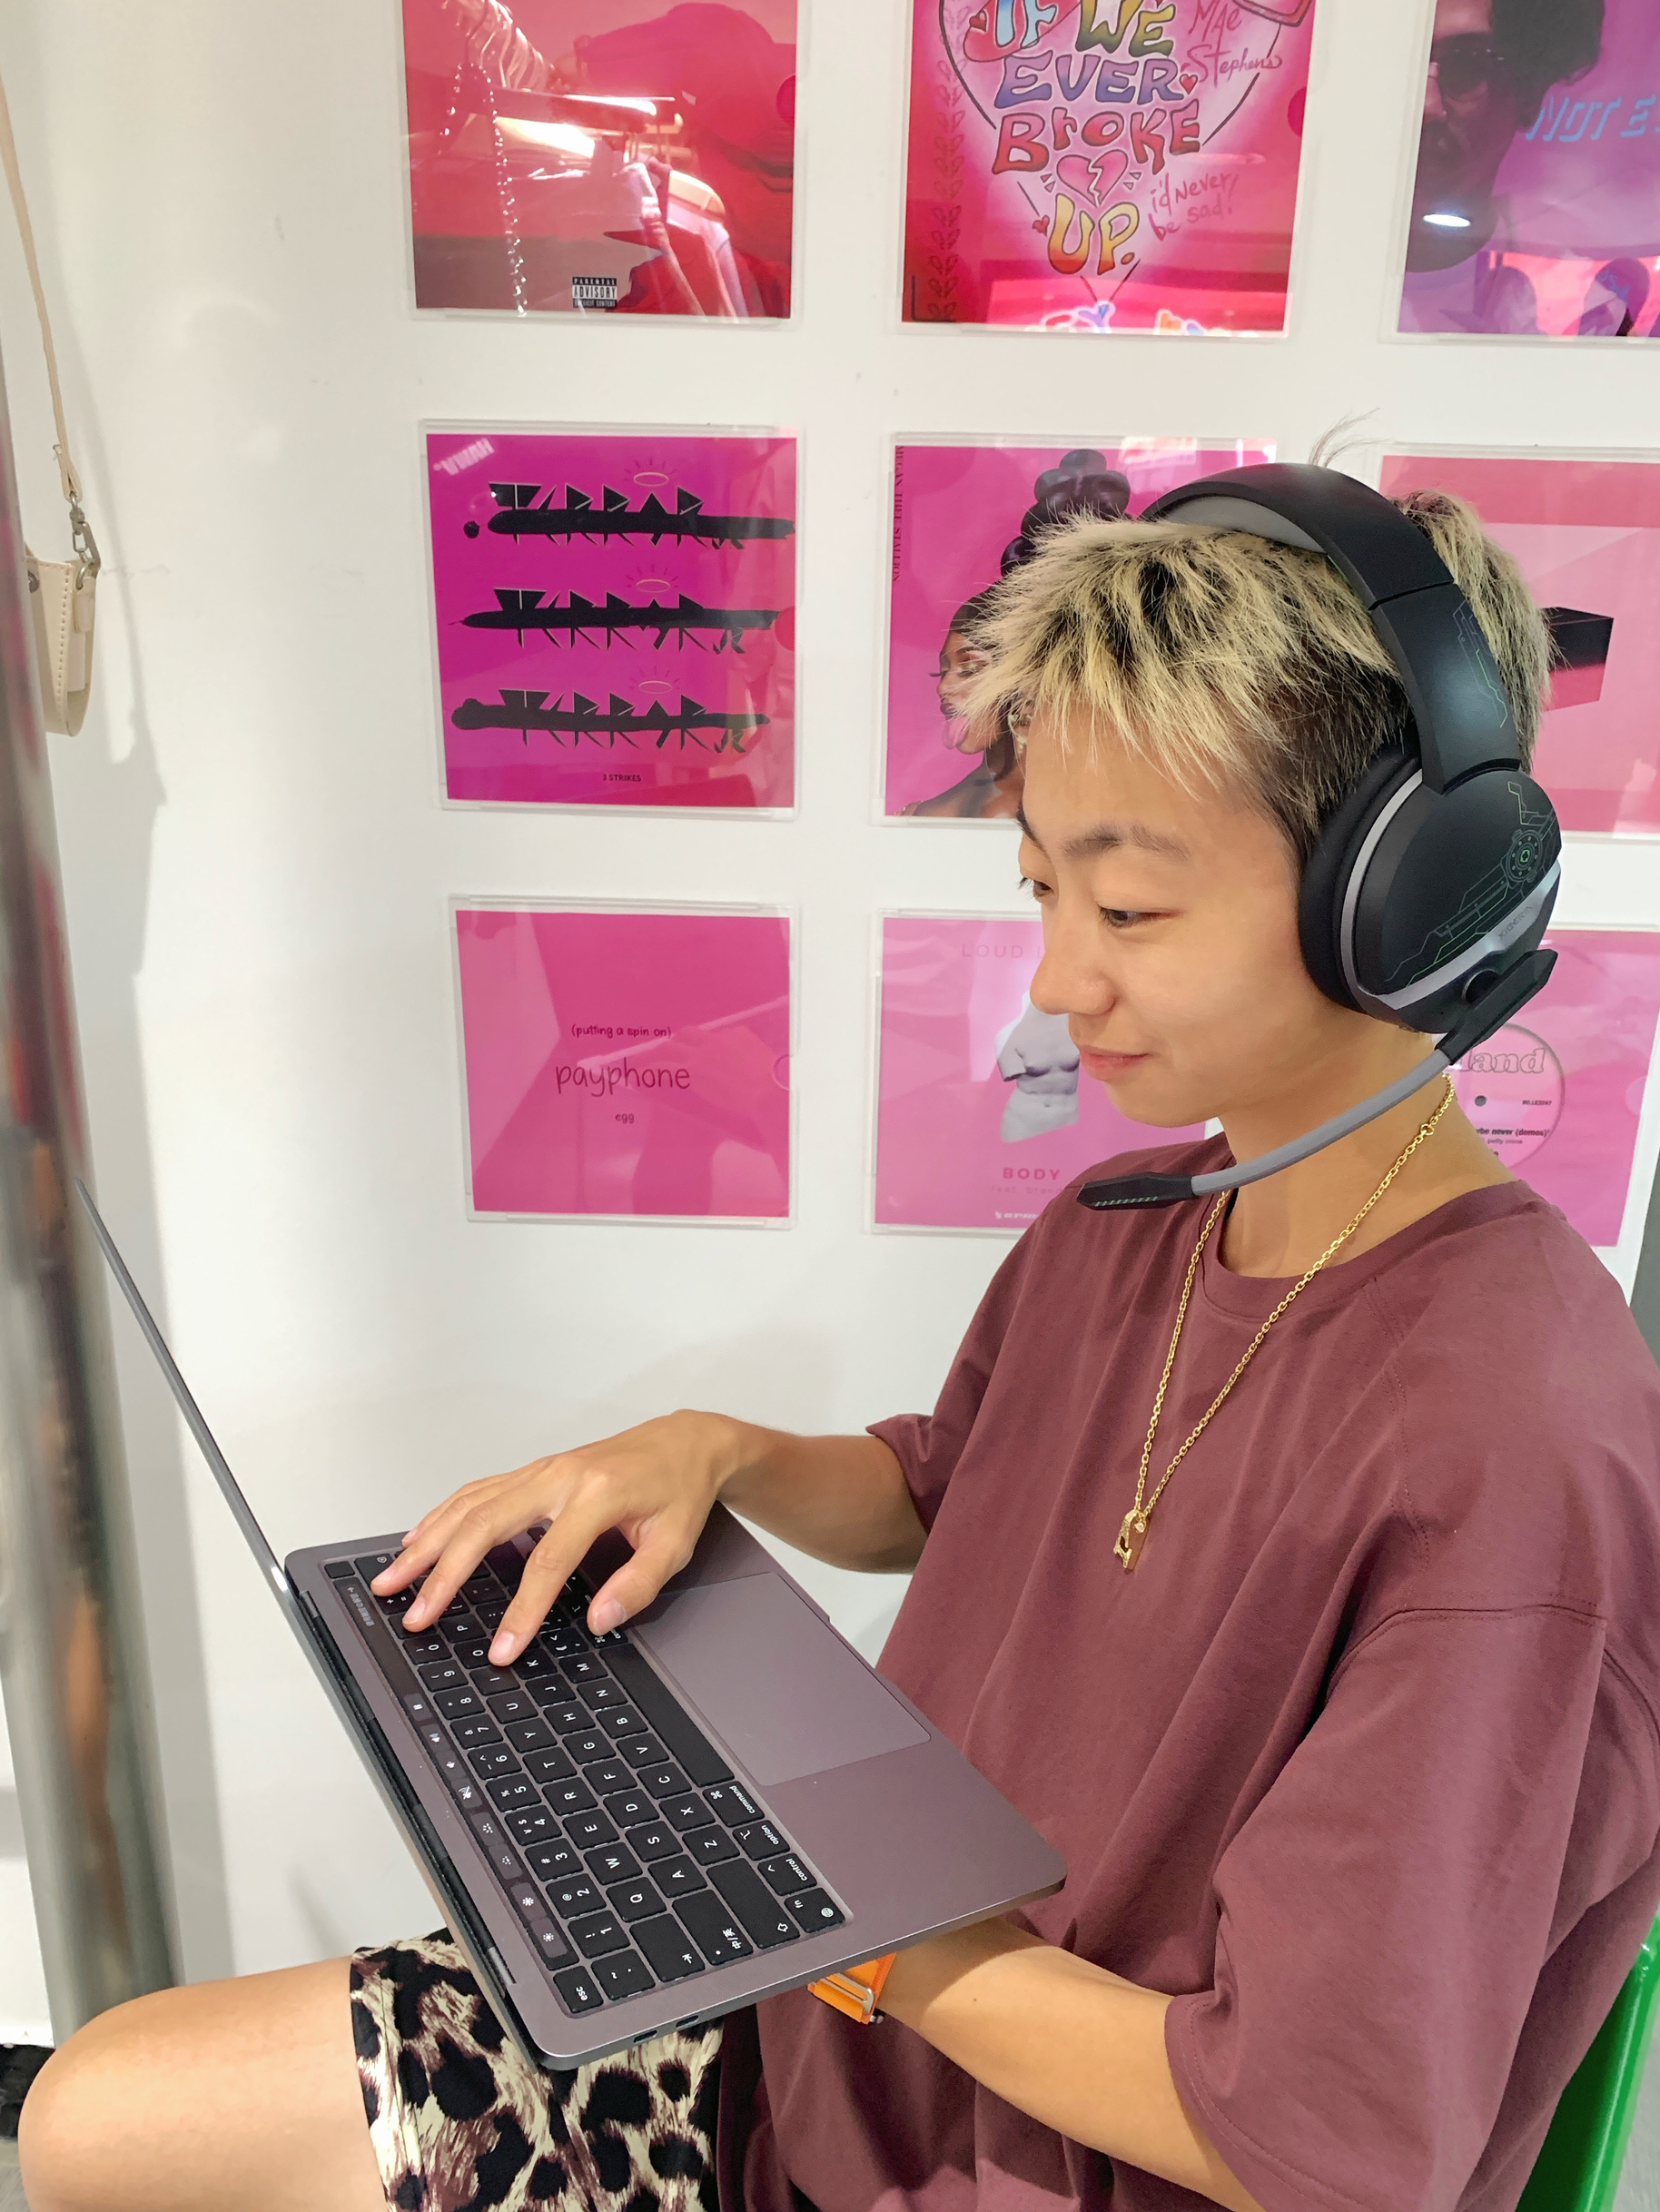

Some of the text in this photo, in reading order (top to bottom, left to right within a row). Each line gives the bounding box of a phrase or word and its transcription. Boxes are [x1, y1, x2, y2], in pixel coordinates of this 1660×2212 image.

[1075, 0, 1176, 56] WE
[993, 50, 1184, 108] EVER
[574, 286, 617, 298] ADVISORY
[608, 774, 642, 782] STRIKES
[963, 944, 1023, 959] LOUD
[571, 1023, 672, 1039] (putting a spin on)
[556, 1057, 690, 1097] payphone
[615, 1113, 635, 1124] egg
[1003, 1167, 1061, 1180] BODY
[729, 1785, 756, 1814] command
[761, 1825, 779, 1845] option
[786, 1858, 807, 1881] control
[794, 1900, 804, 1909] fn
[723, 1928, 742, 1950] 中/英
[576, 1986, 588, 2001] esc
